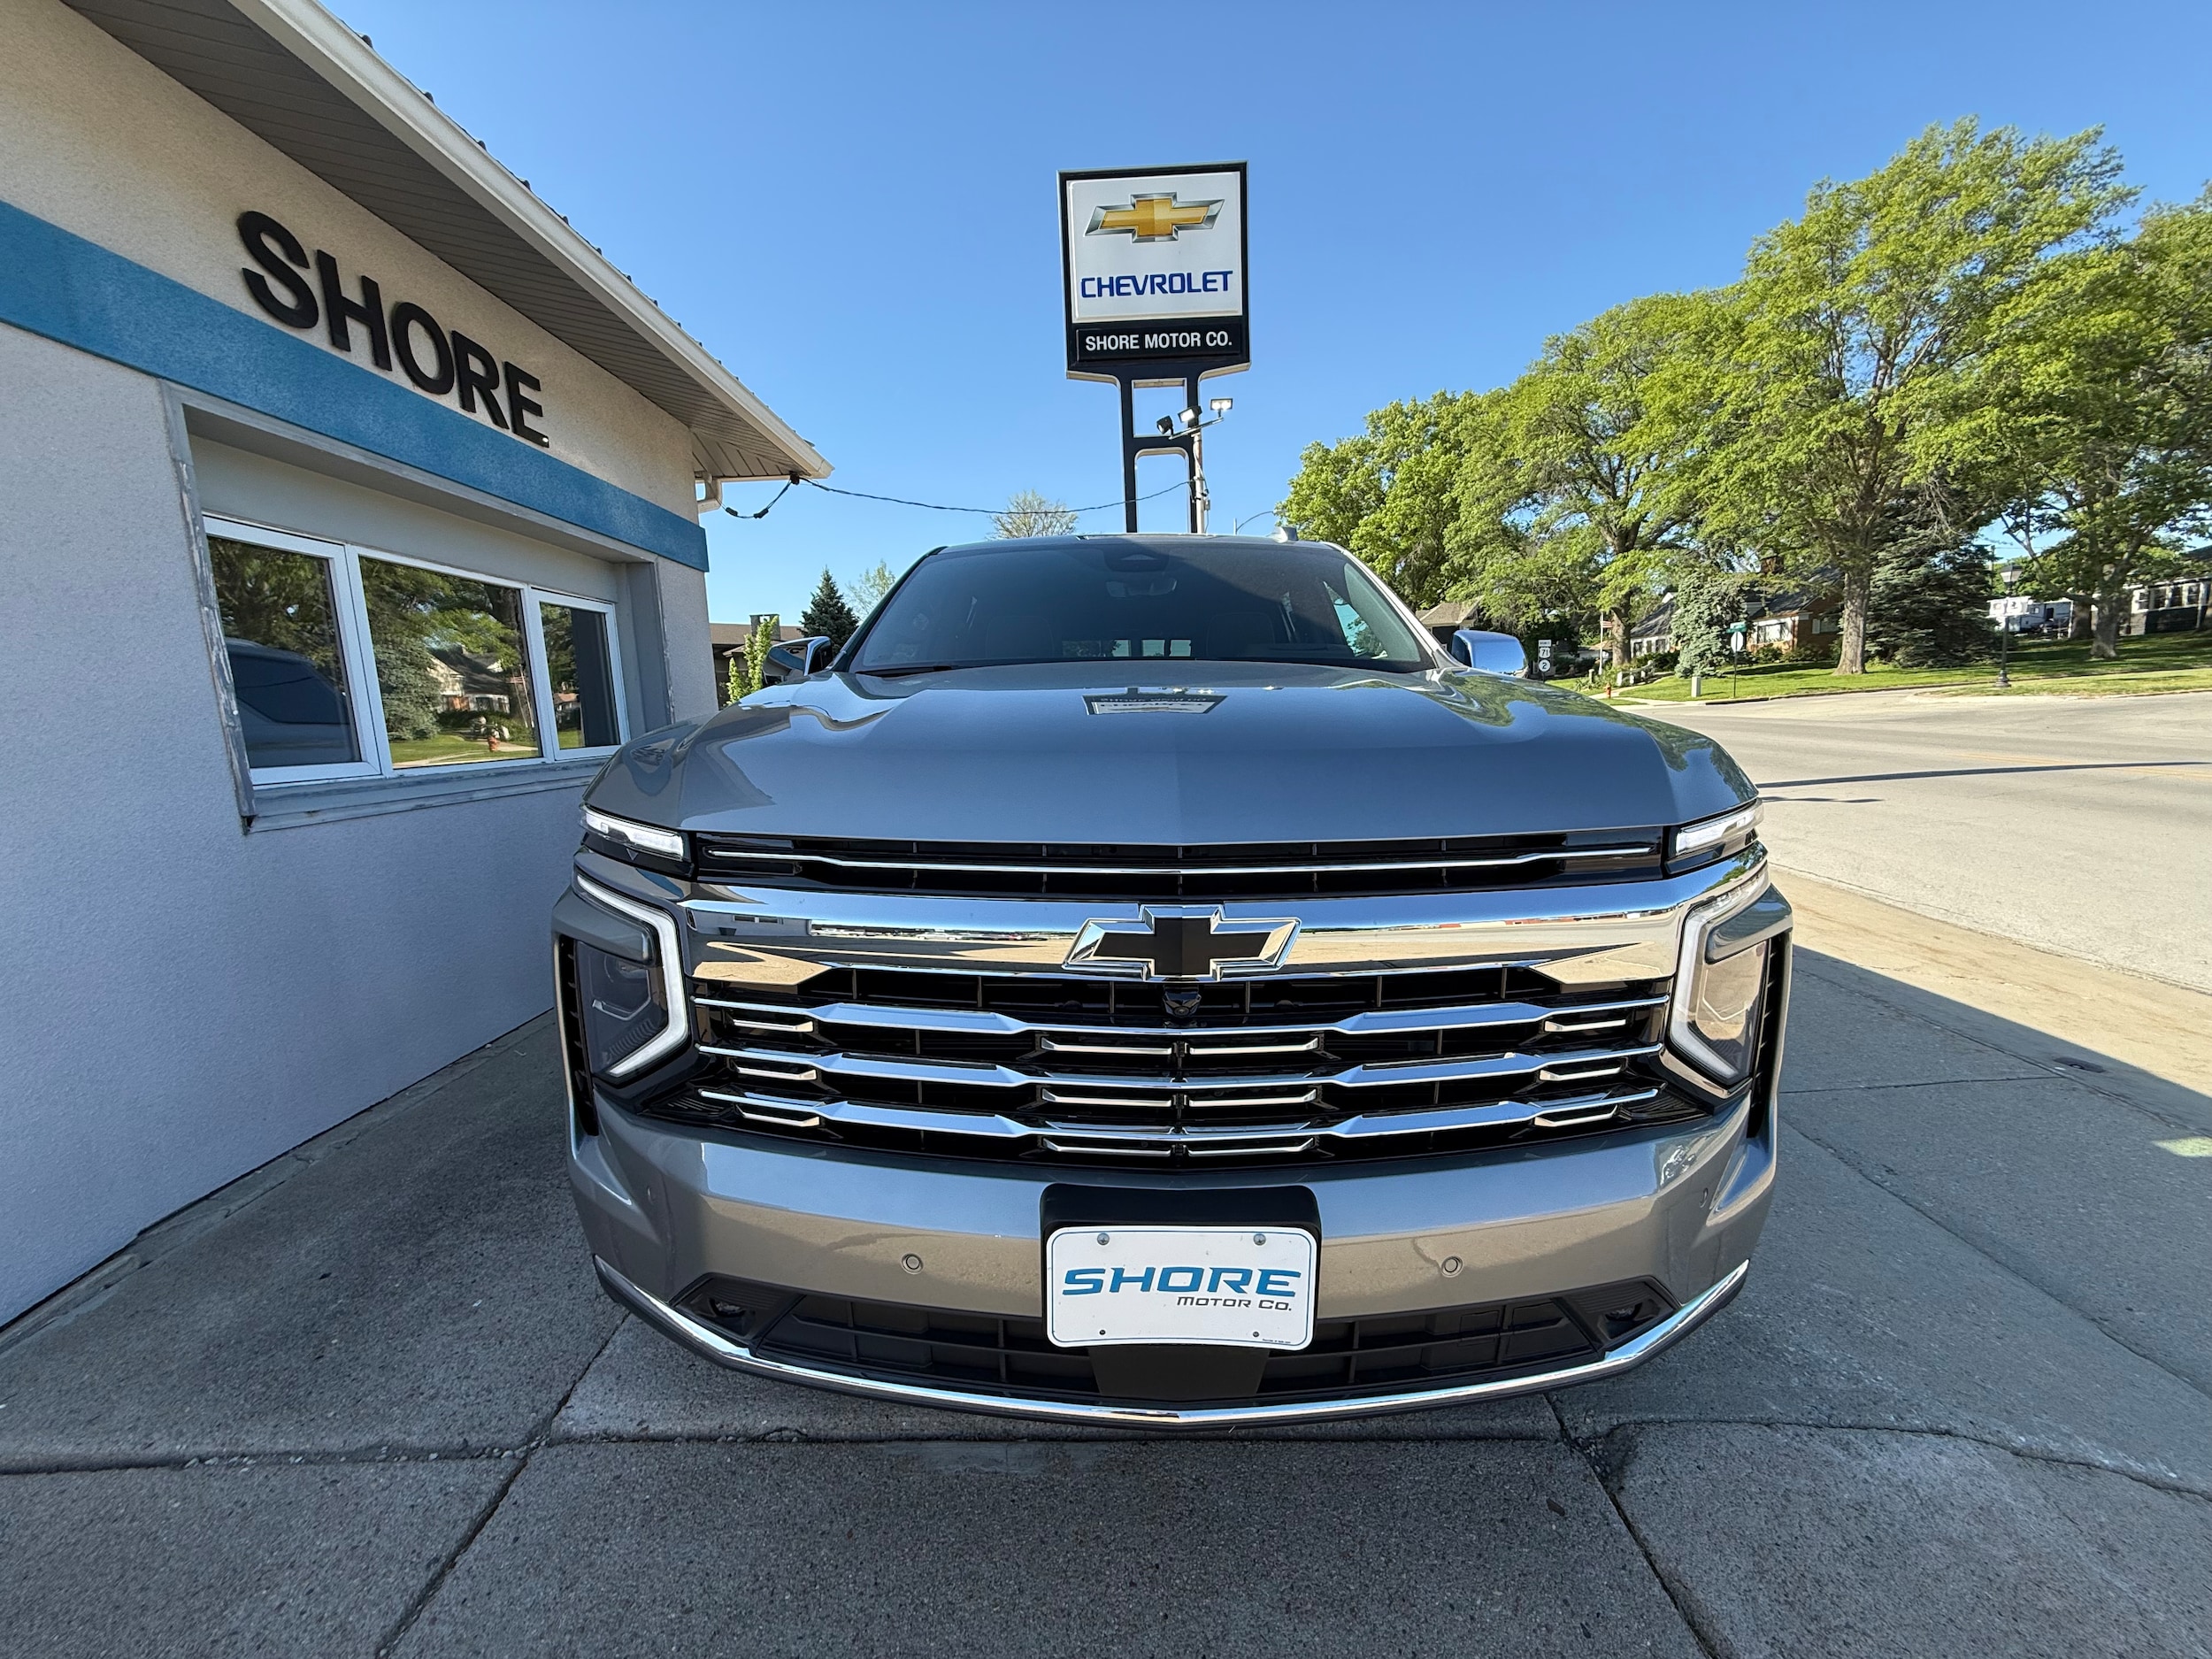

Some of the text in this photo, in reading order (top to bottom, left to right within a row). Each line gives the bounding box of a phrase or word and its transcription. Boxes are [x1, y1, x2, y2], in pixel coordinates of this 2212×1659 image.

[1081, 270, 1233, 297] CHEVROLET
[237, 211, 549, 448] SHORE
[1085, 331, 1233, 351] SHORE MOTOR CO.
[1062, 1266, 1302, 1297] SHORE
[1177, 1296, 1252, 1308] MOTOR
